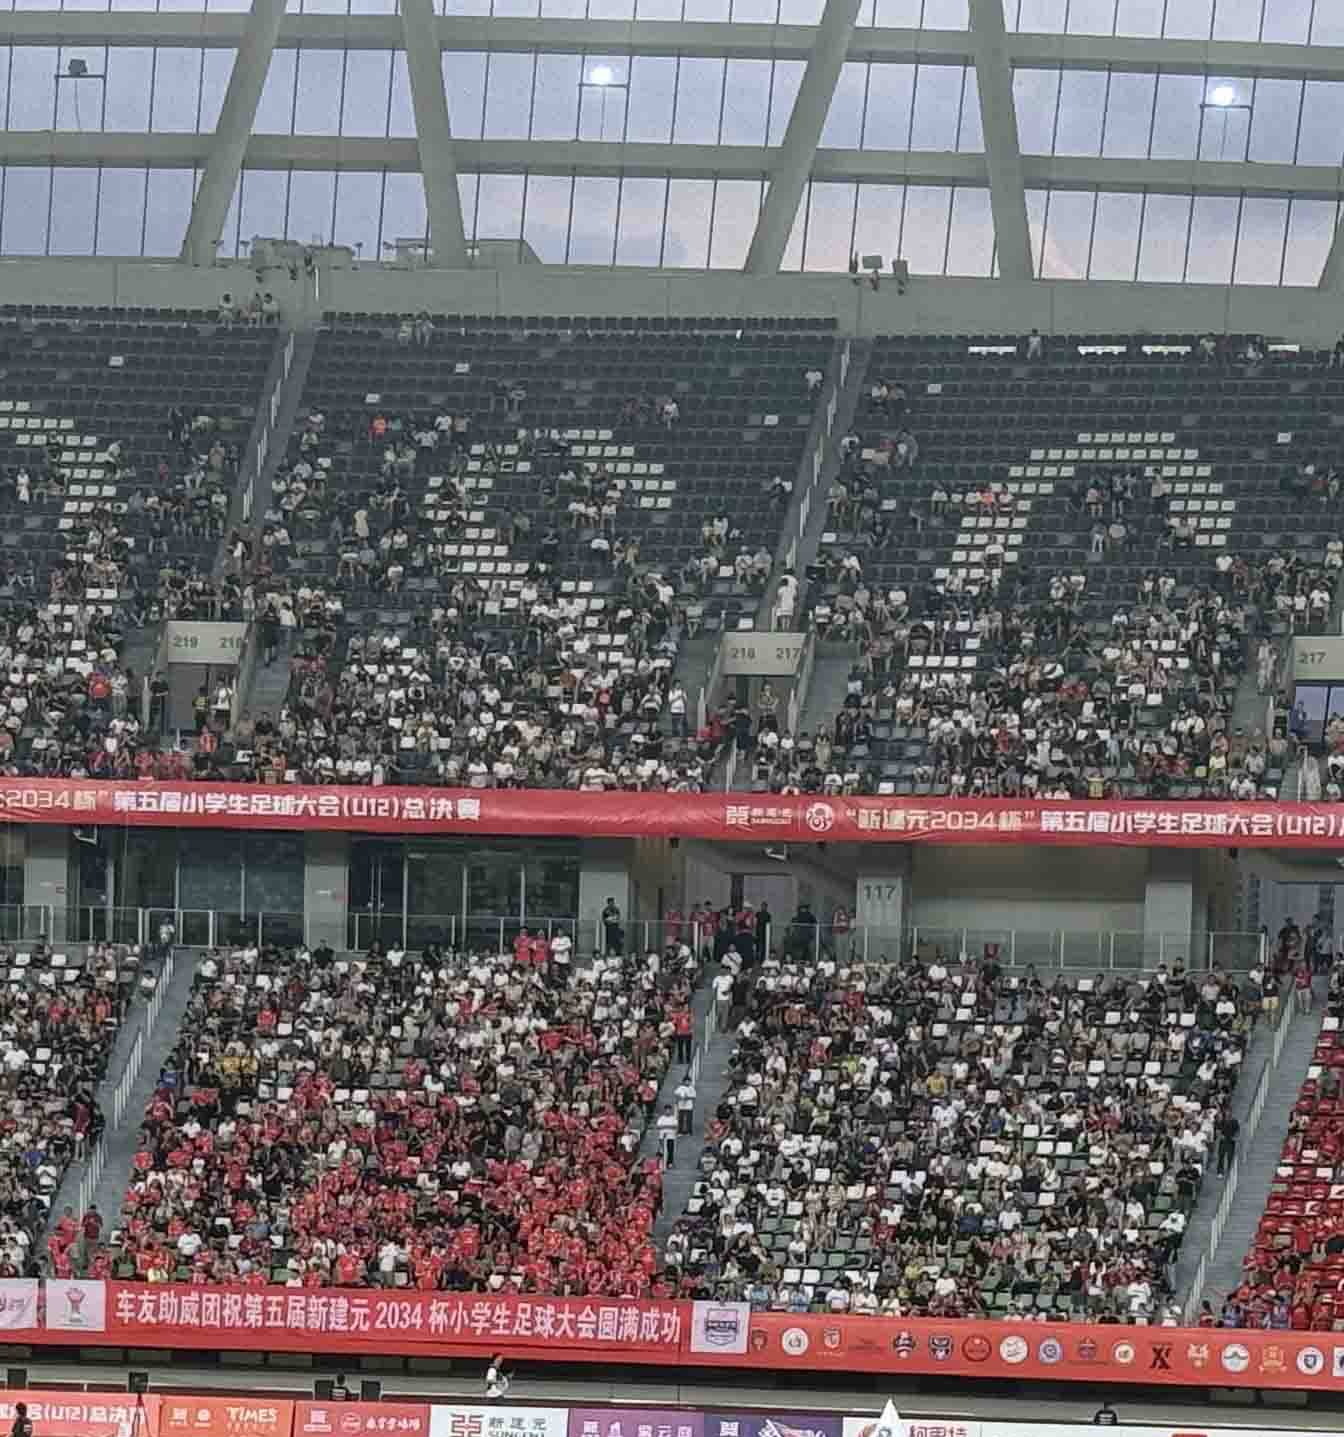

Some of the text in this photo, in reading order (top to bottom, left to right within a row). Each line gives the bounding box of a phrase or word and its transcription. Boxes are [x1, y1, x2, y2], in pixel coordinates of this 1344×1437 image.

[776, 647, 801, 660] 217
[1299, 652, 1326, 664] 217
[863, 884, 896, 900] 117
[116, 1288, 681, 1347] 车友助威团祝第五届新建元 2034 杯小学生足球大会圆满成功
[225, 1407, 278, 1424] TIMES
